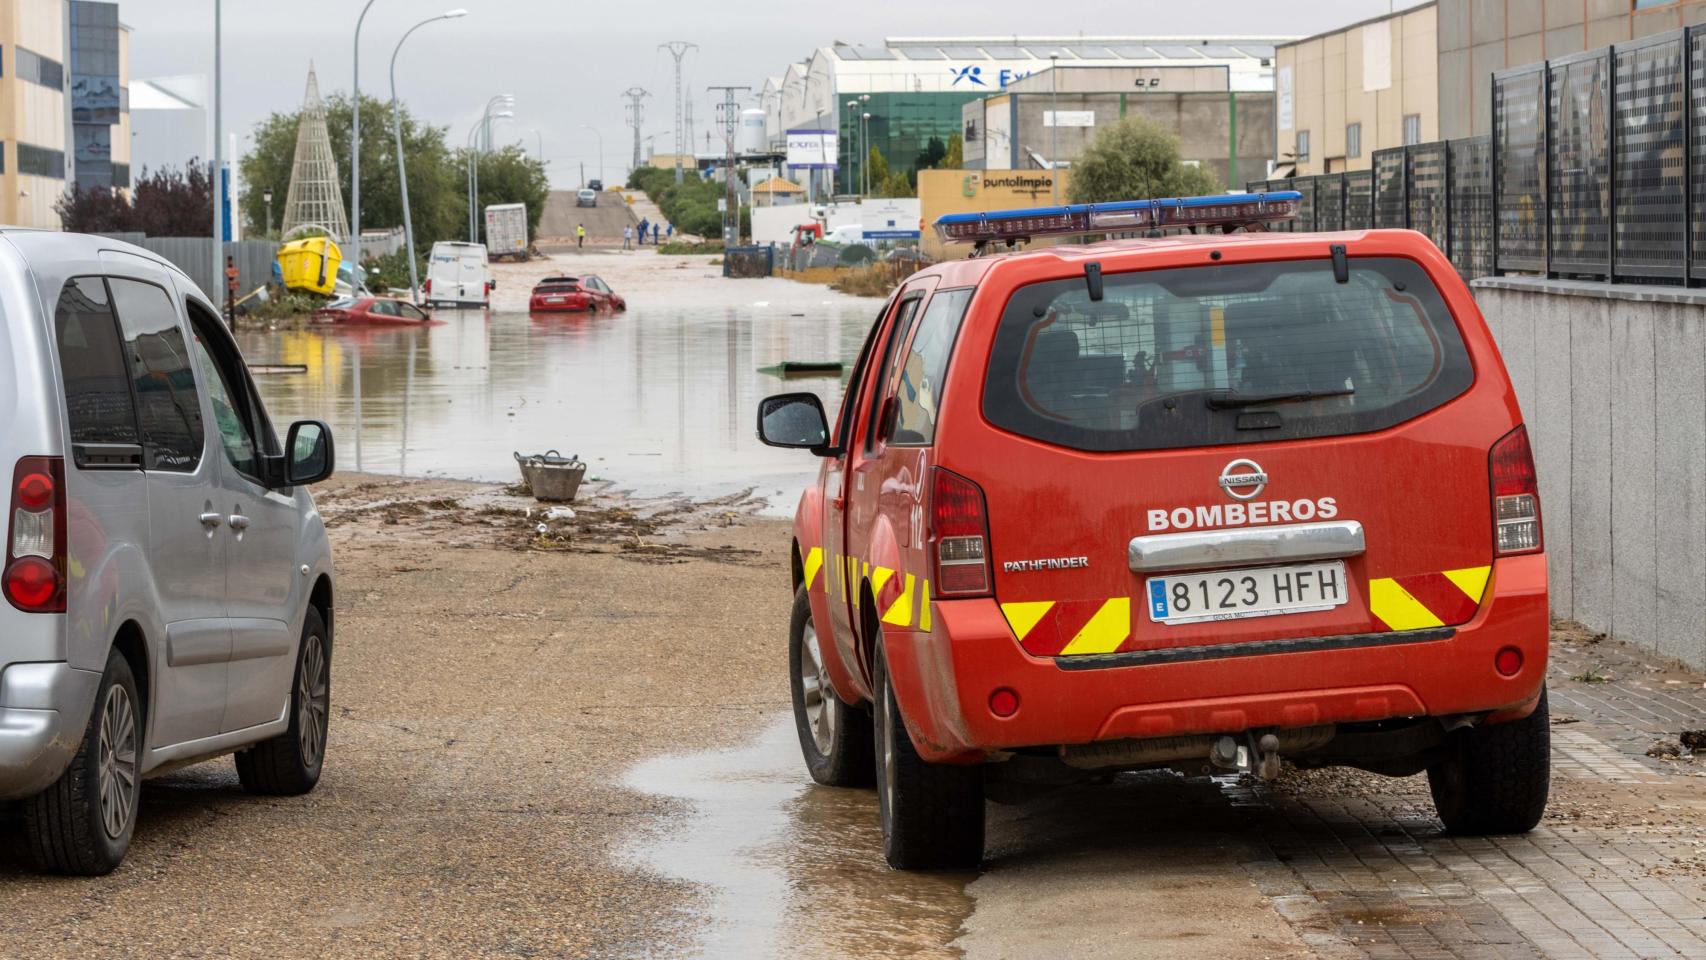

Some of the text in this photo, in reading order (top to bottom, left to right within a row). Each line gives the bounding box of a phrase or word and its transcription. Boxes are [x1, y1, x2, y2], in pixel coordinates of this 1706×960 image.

[983, 175, 1053, 189] puntolimpio
[1223, 474, 1264, 485] NISSAN
[911, 503, 923, 550] 112
[1147, 497, 1338, 531] BOMBEROS
[1003, 556, 1089, 572] PATHFINDER
[1156, 569, 1338, 612] E 8123 HFH
